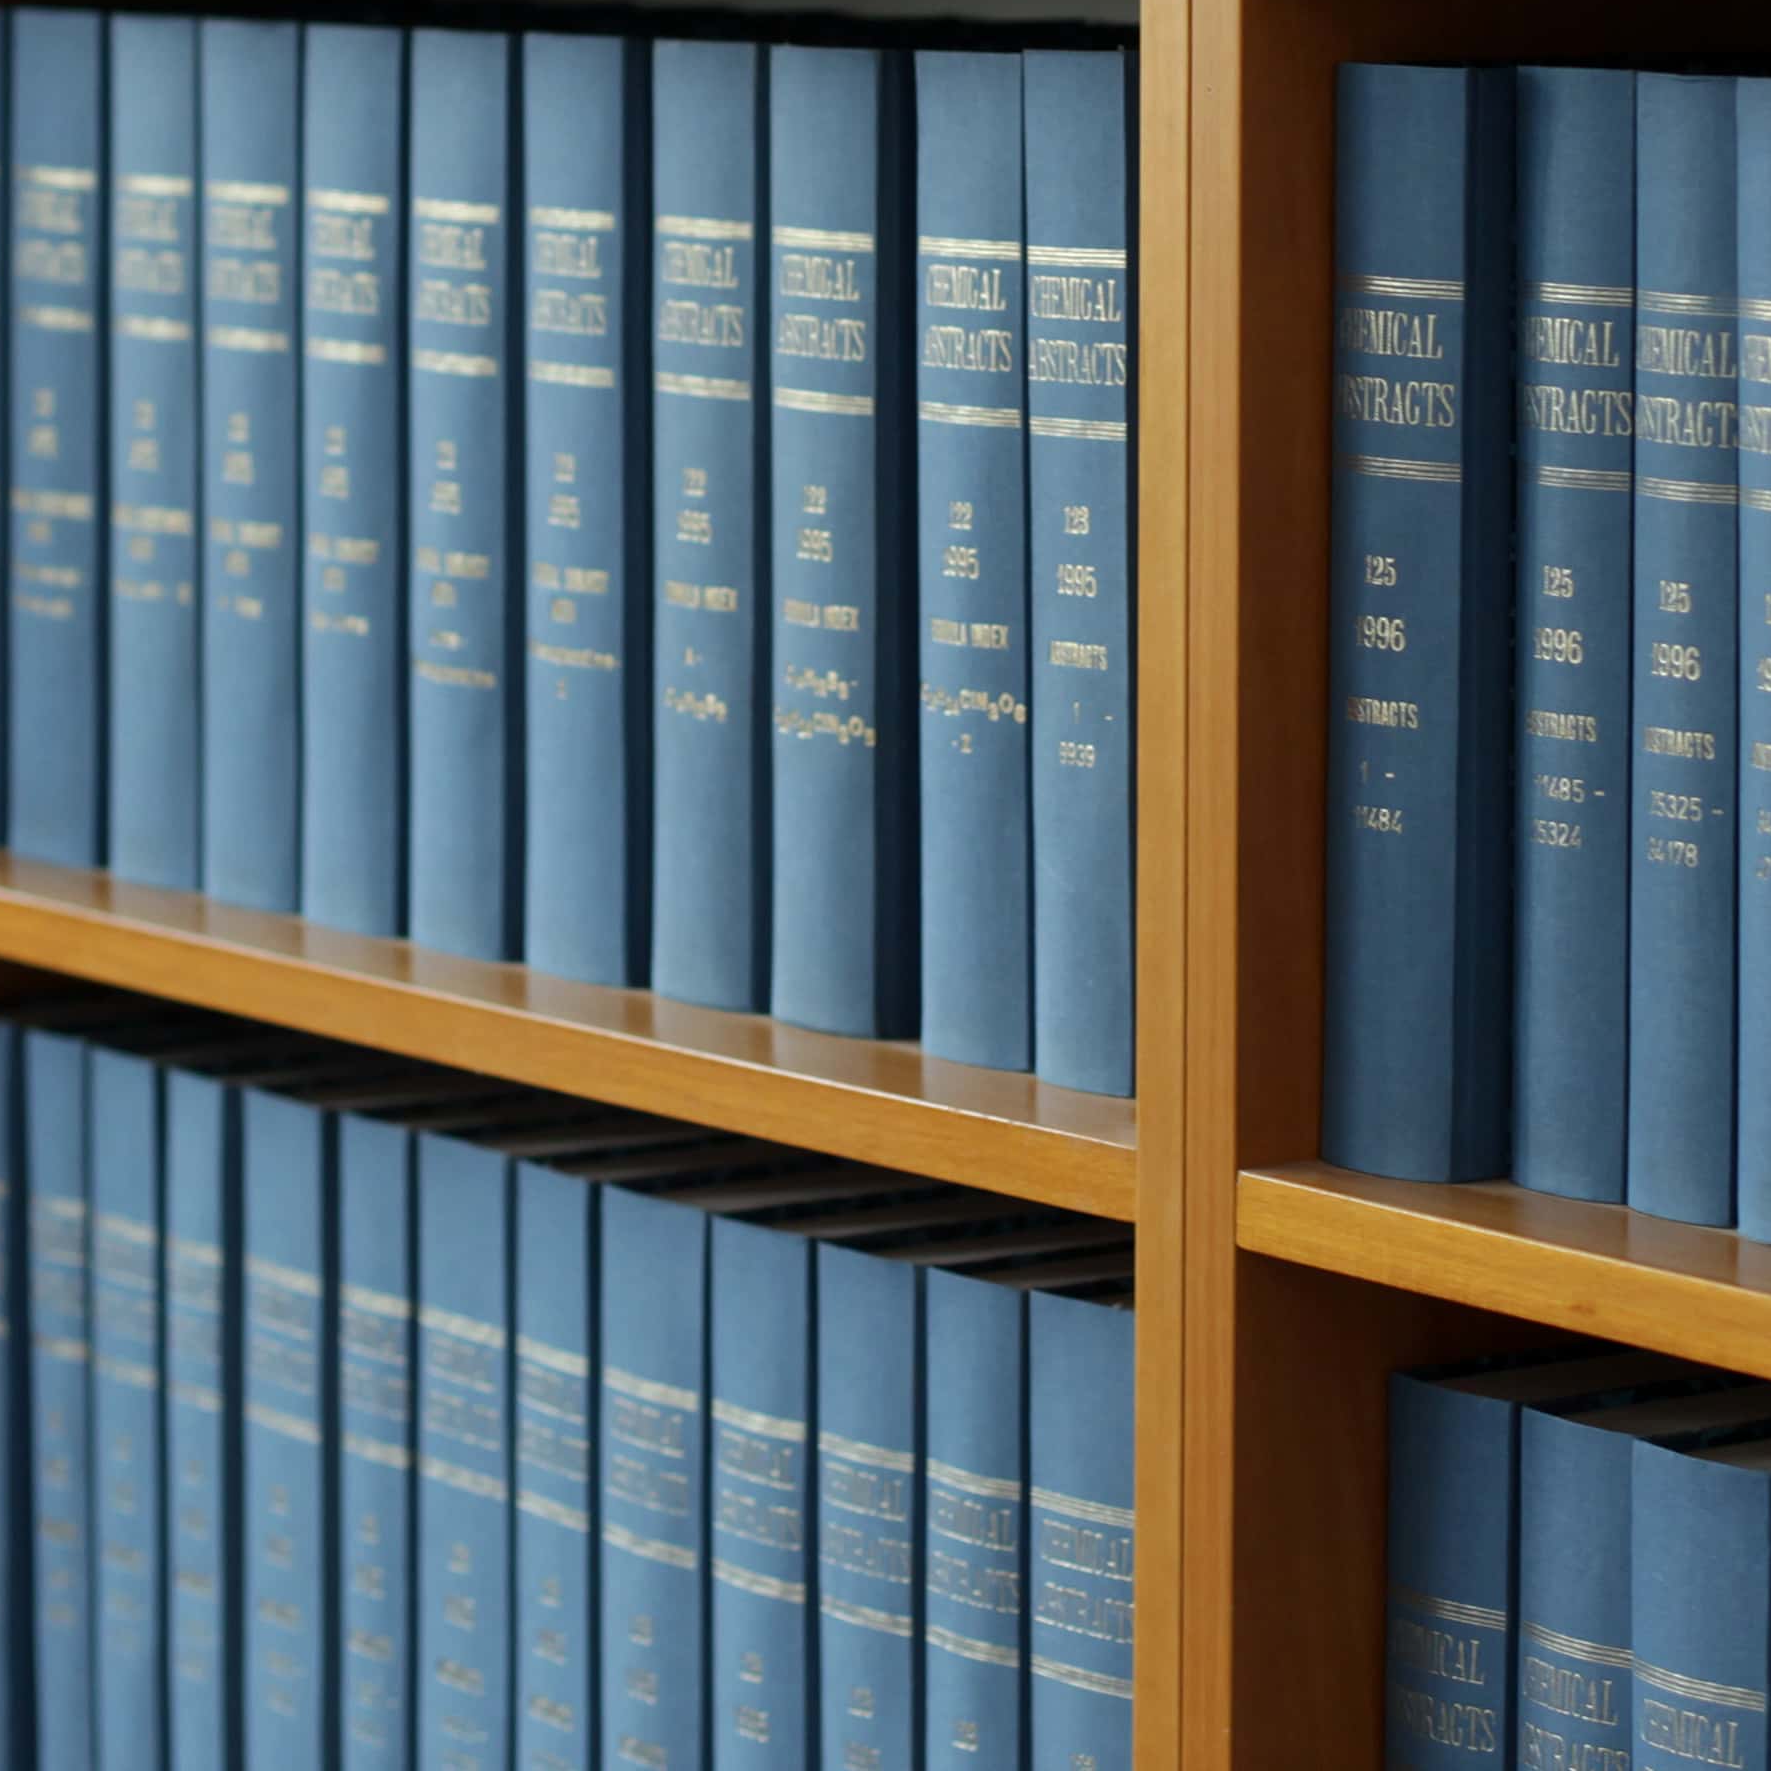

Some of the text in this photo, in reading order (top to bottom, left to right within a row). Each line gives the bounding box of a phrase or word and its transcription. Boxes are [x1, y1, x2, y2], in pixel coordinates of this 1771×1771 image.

[1030, 275, 1123, 323] CHEMICAL
[921, 324, 1013, 373] ABSTRACTS
[1028, 337, 1127, 386] ABSTRACTS
[1636, 394, 1738, 449] ABSTRACT
[1364, 555, 1397, 586] 125
[1543, 564, 1574, 599] 125
[1659, 580, 1692, 614] 125
[1356, 615, 1406, 652] 1996
[1533, 626, 1584, 665] 1996
[1651, 642, 1701, 682] 1996
